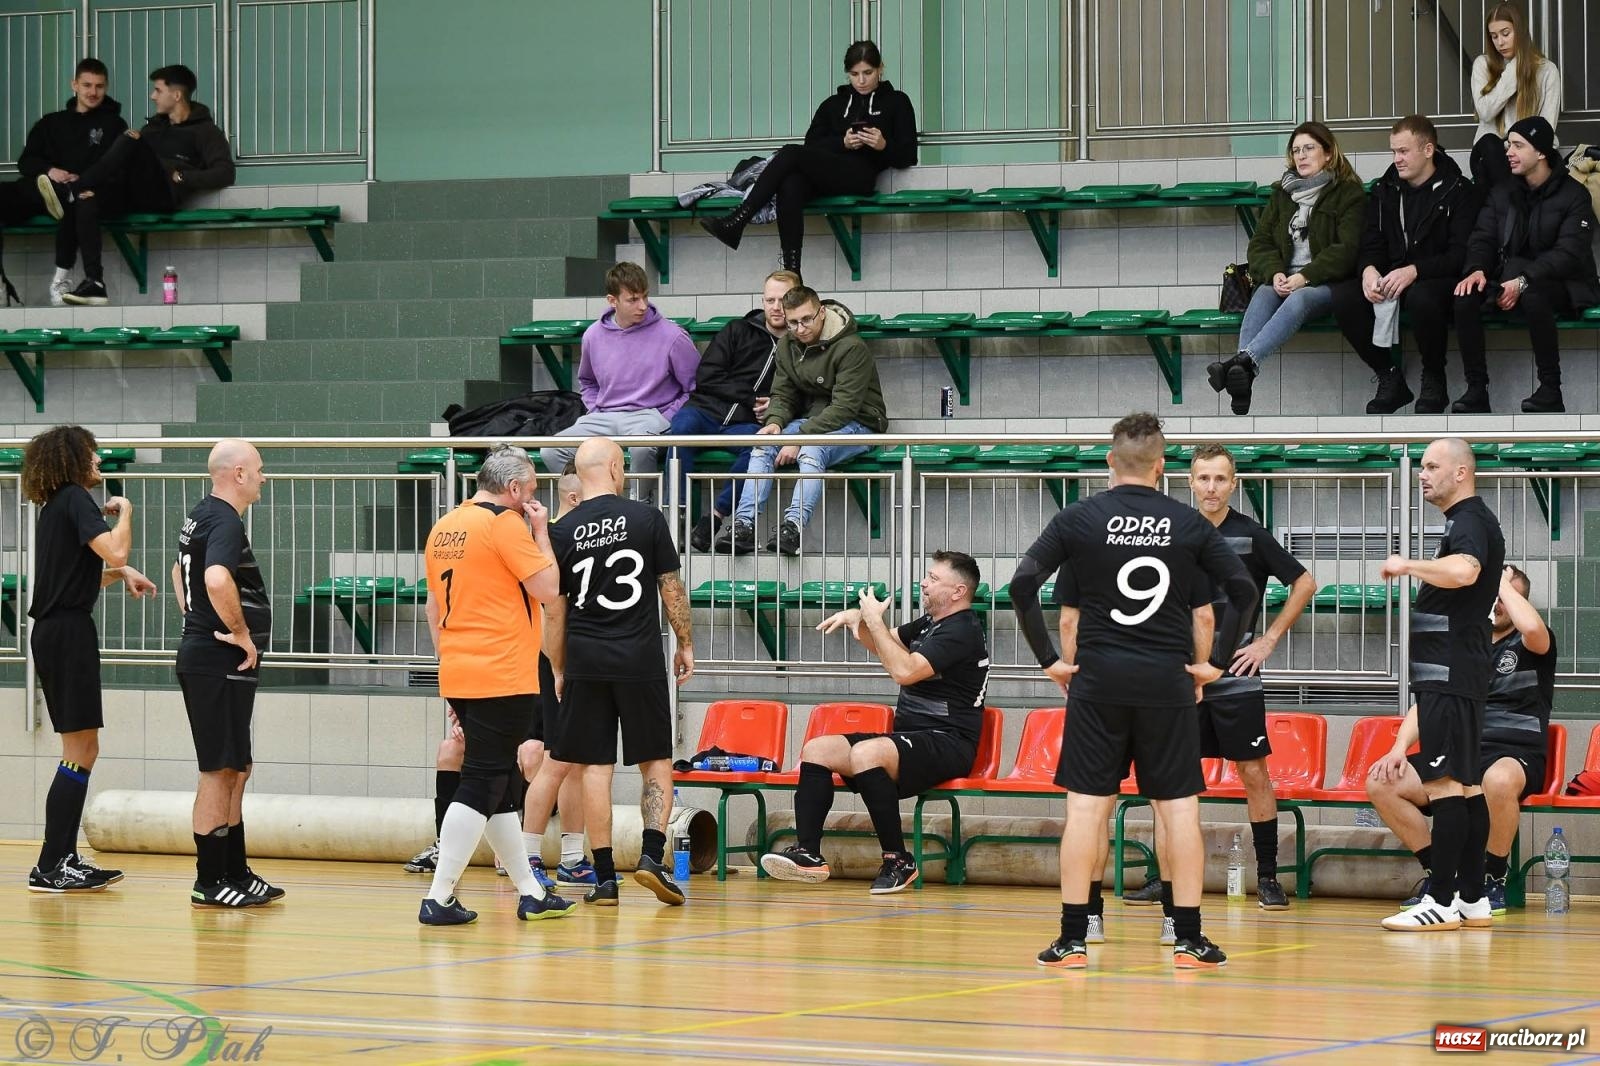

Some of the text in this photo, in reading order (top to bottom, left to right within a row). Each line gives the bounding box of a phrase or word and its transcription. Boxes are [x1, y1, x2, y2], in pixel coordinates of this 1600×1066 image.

[573, 515, 627, 541] ODRA
[1106, 515, 1171, 534] ODRA
[433, 531, 467, 548] ODRA
[576, 531, 628, 551] RACIBÓRZ
[1106, 533, 1171, 547] RACIBÓRZ
[571, 548, 644, 610] 13
[1110, 556, 1170, 625] 9
